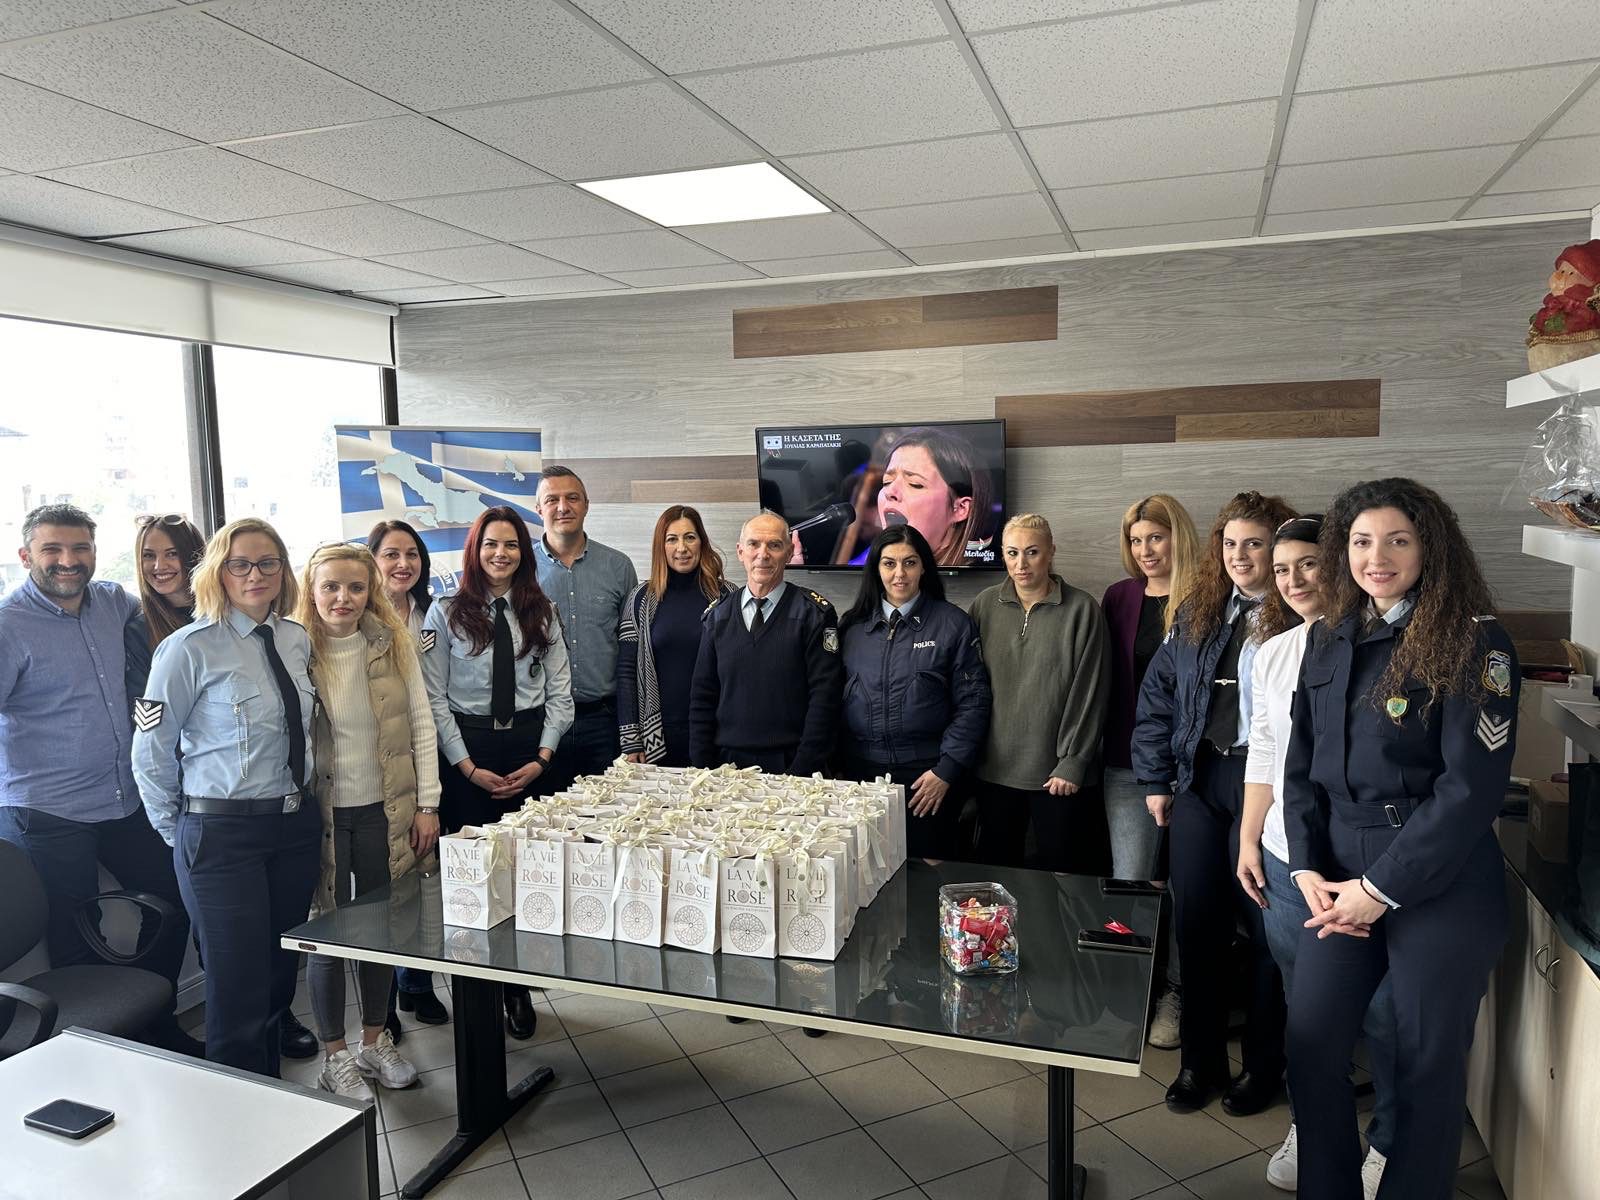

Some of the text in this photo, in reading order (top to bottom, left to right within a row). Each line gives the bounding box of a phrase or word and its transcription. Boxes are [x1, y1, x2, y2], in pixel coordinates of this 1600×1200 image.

[791, 434, 823, 442] ΚΑΣΕΤΑ
[824, 433, 842, 441] ΤΗΣ
[913, 640, 936, 649] POLICE
[463, 848, 480, 860] VIE
[523, 849, 558, 864] LA VIE
[677, 860, 691, 873] LA
[522, 868, 558, 885] ROSE
[571, 872, 608, 888] ROSE
[727, 868, 742, 881] LA
[620, 875, 656, 893] ROSE
[676, 879, 711, 900] ROSE
[727, 888, 767, 905] ROSE
[786, 888, 828, 904] RSE
